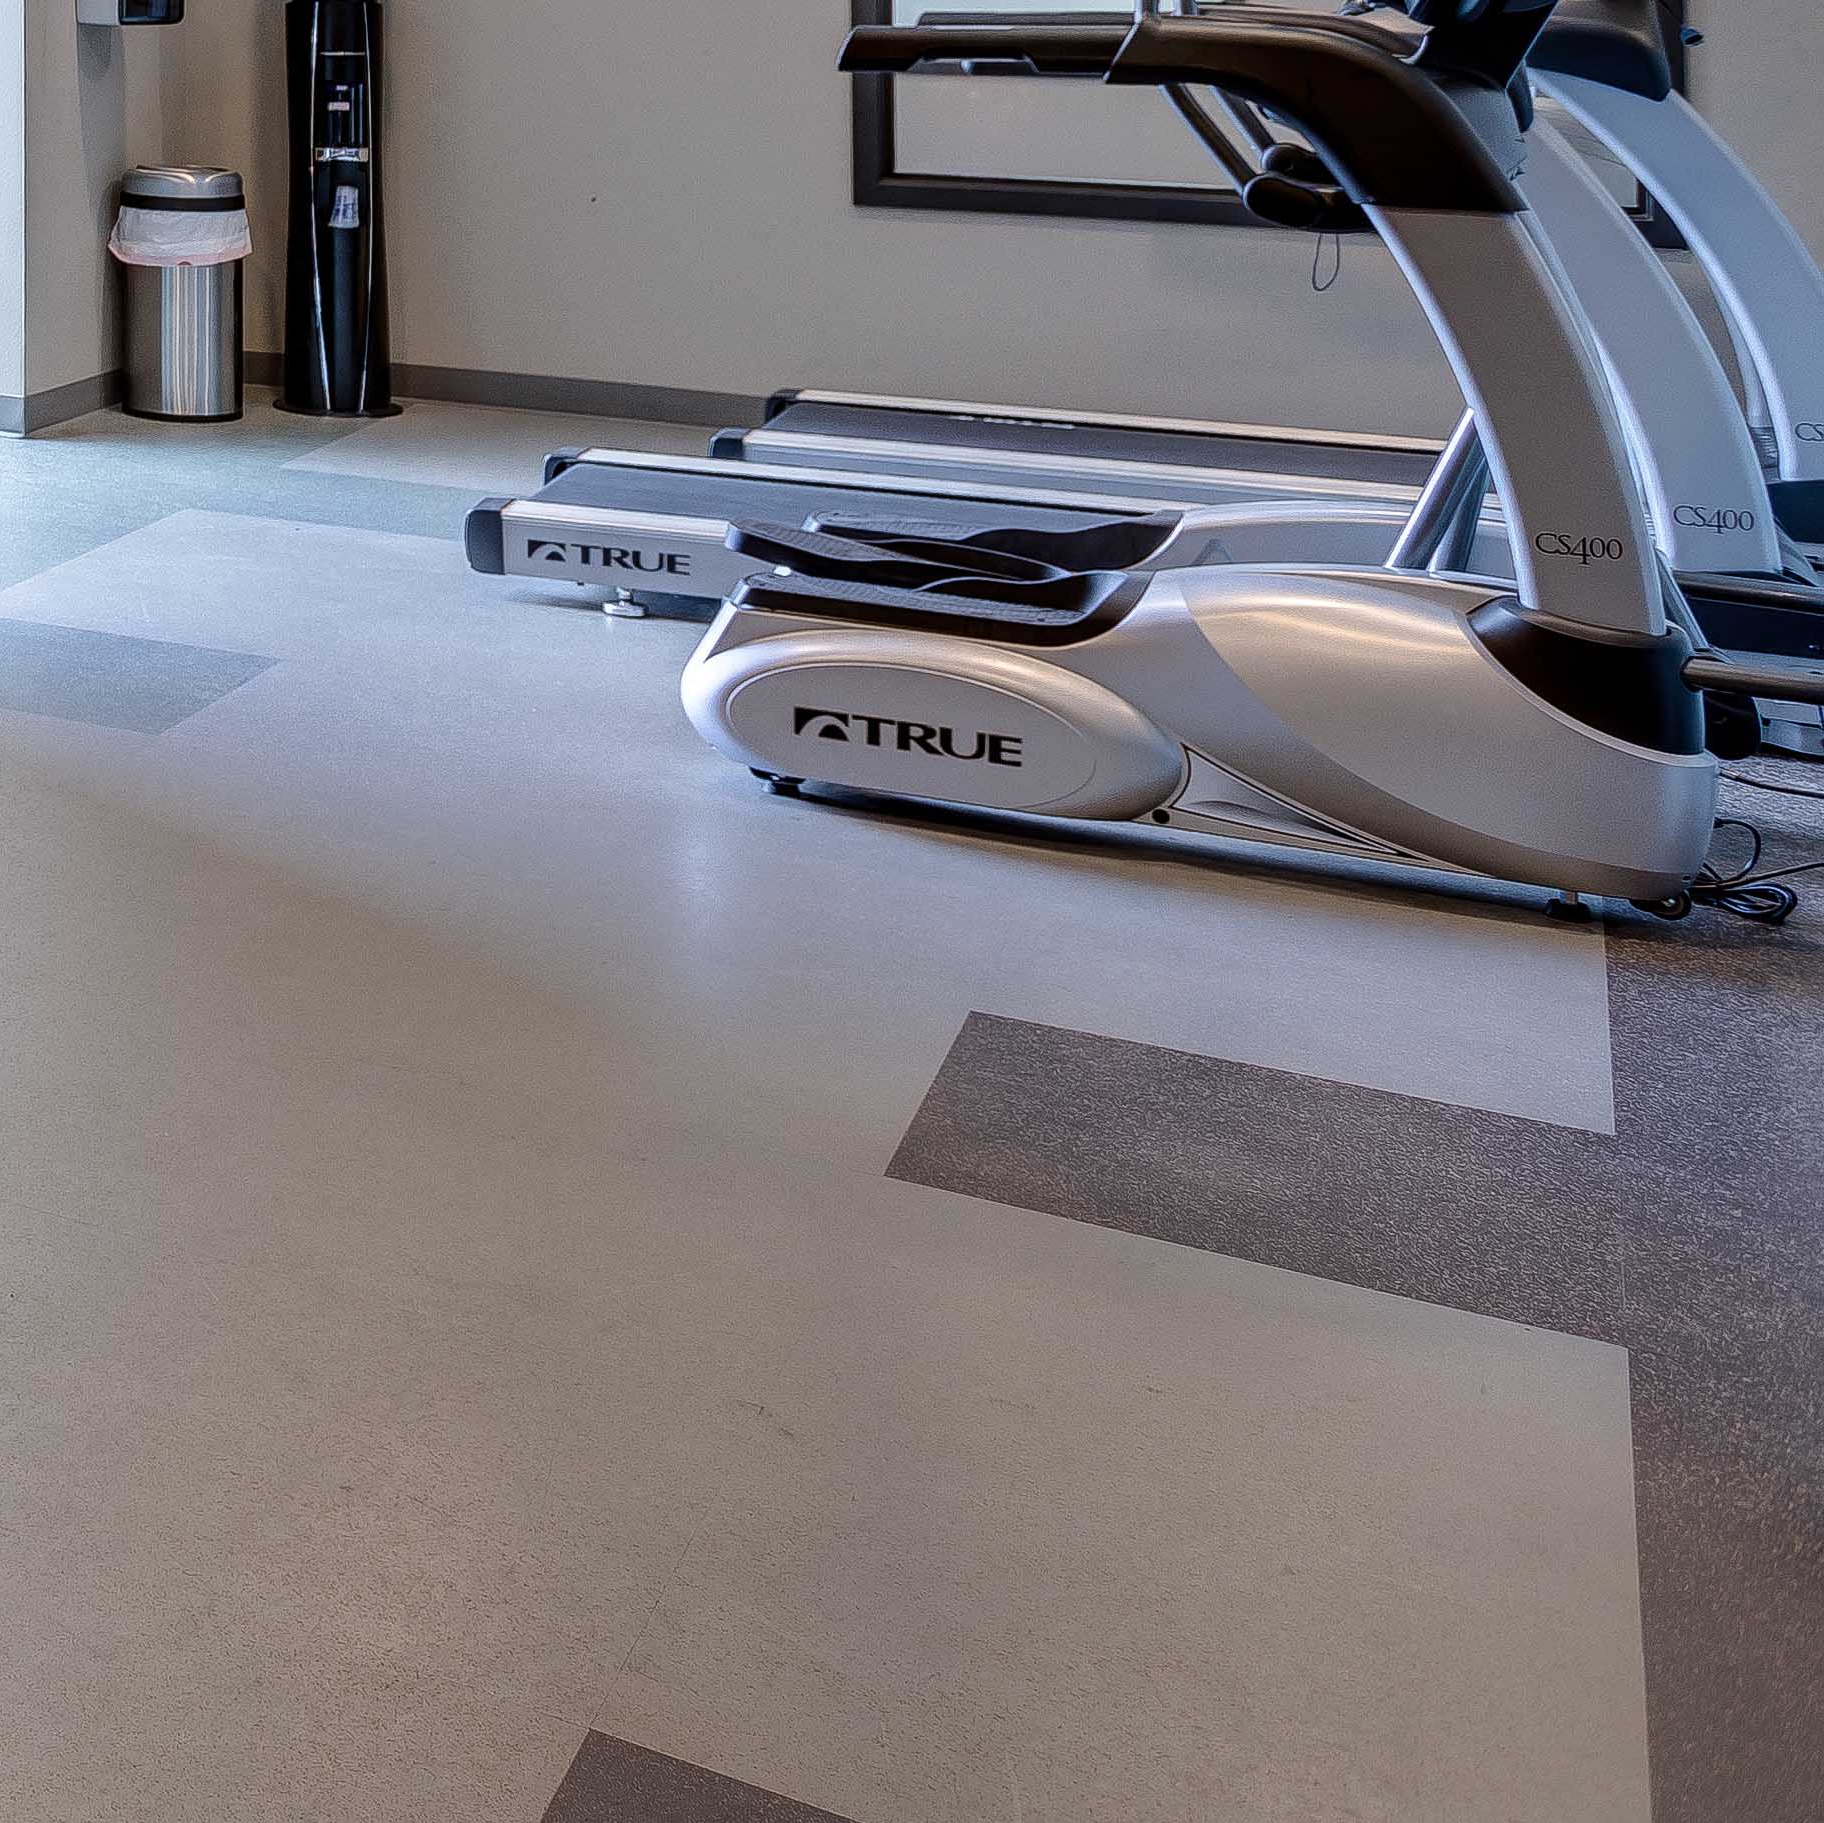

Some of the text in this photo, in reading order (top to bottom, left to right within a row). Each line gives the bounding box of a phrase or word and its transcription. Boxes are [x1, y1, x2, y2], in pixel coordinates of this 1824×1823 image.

[1673, 504, 1754, 534] CS400
[571, 543, 692, 576] TRUE
[1534, 531, 1624, 566] CS400
[850, 715, 1024, 768] TRUE
